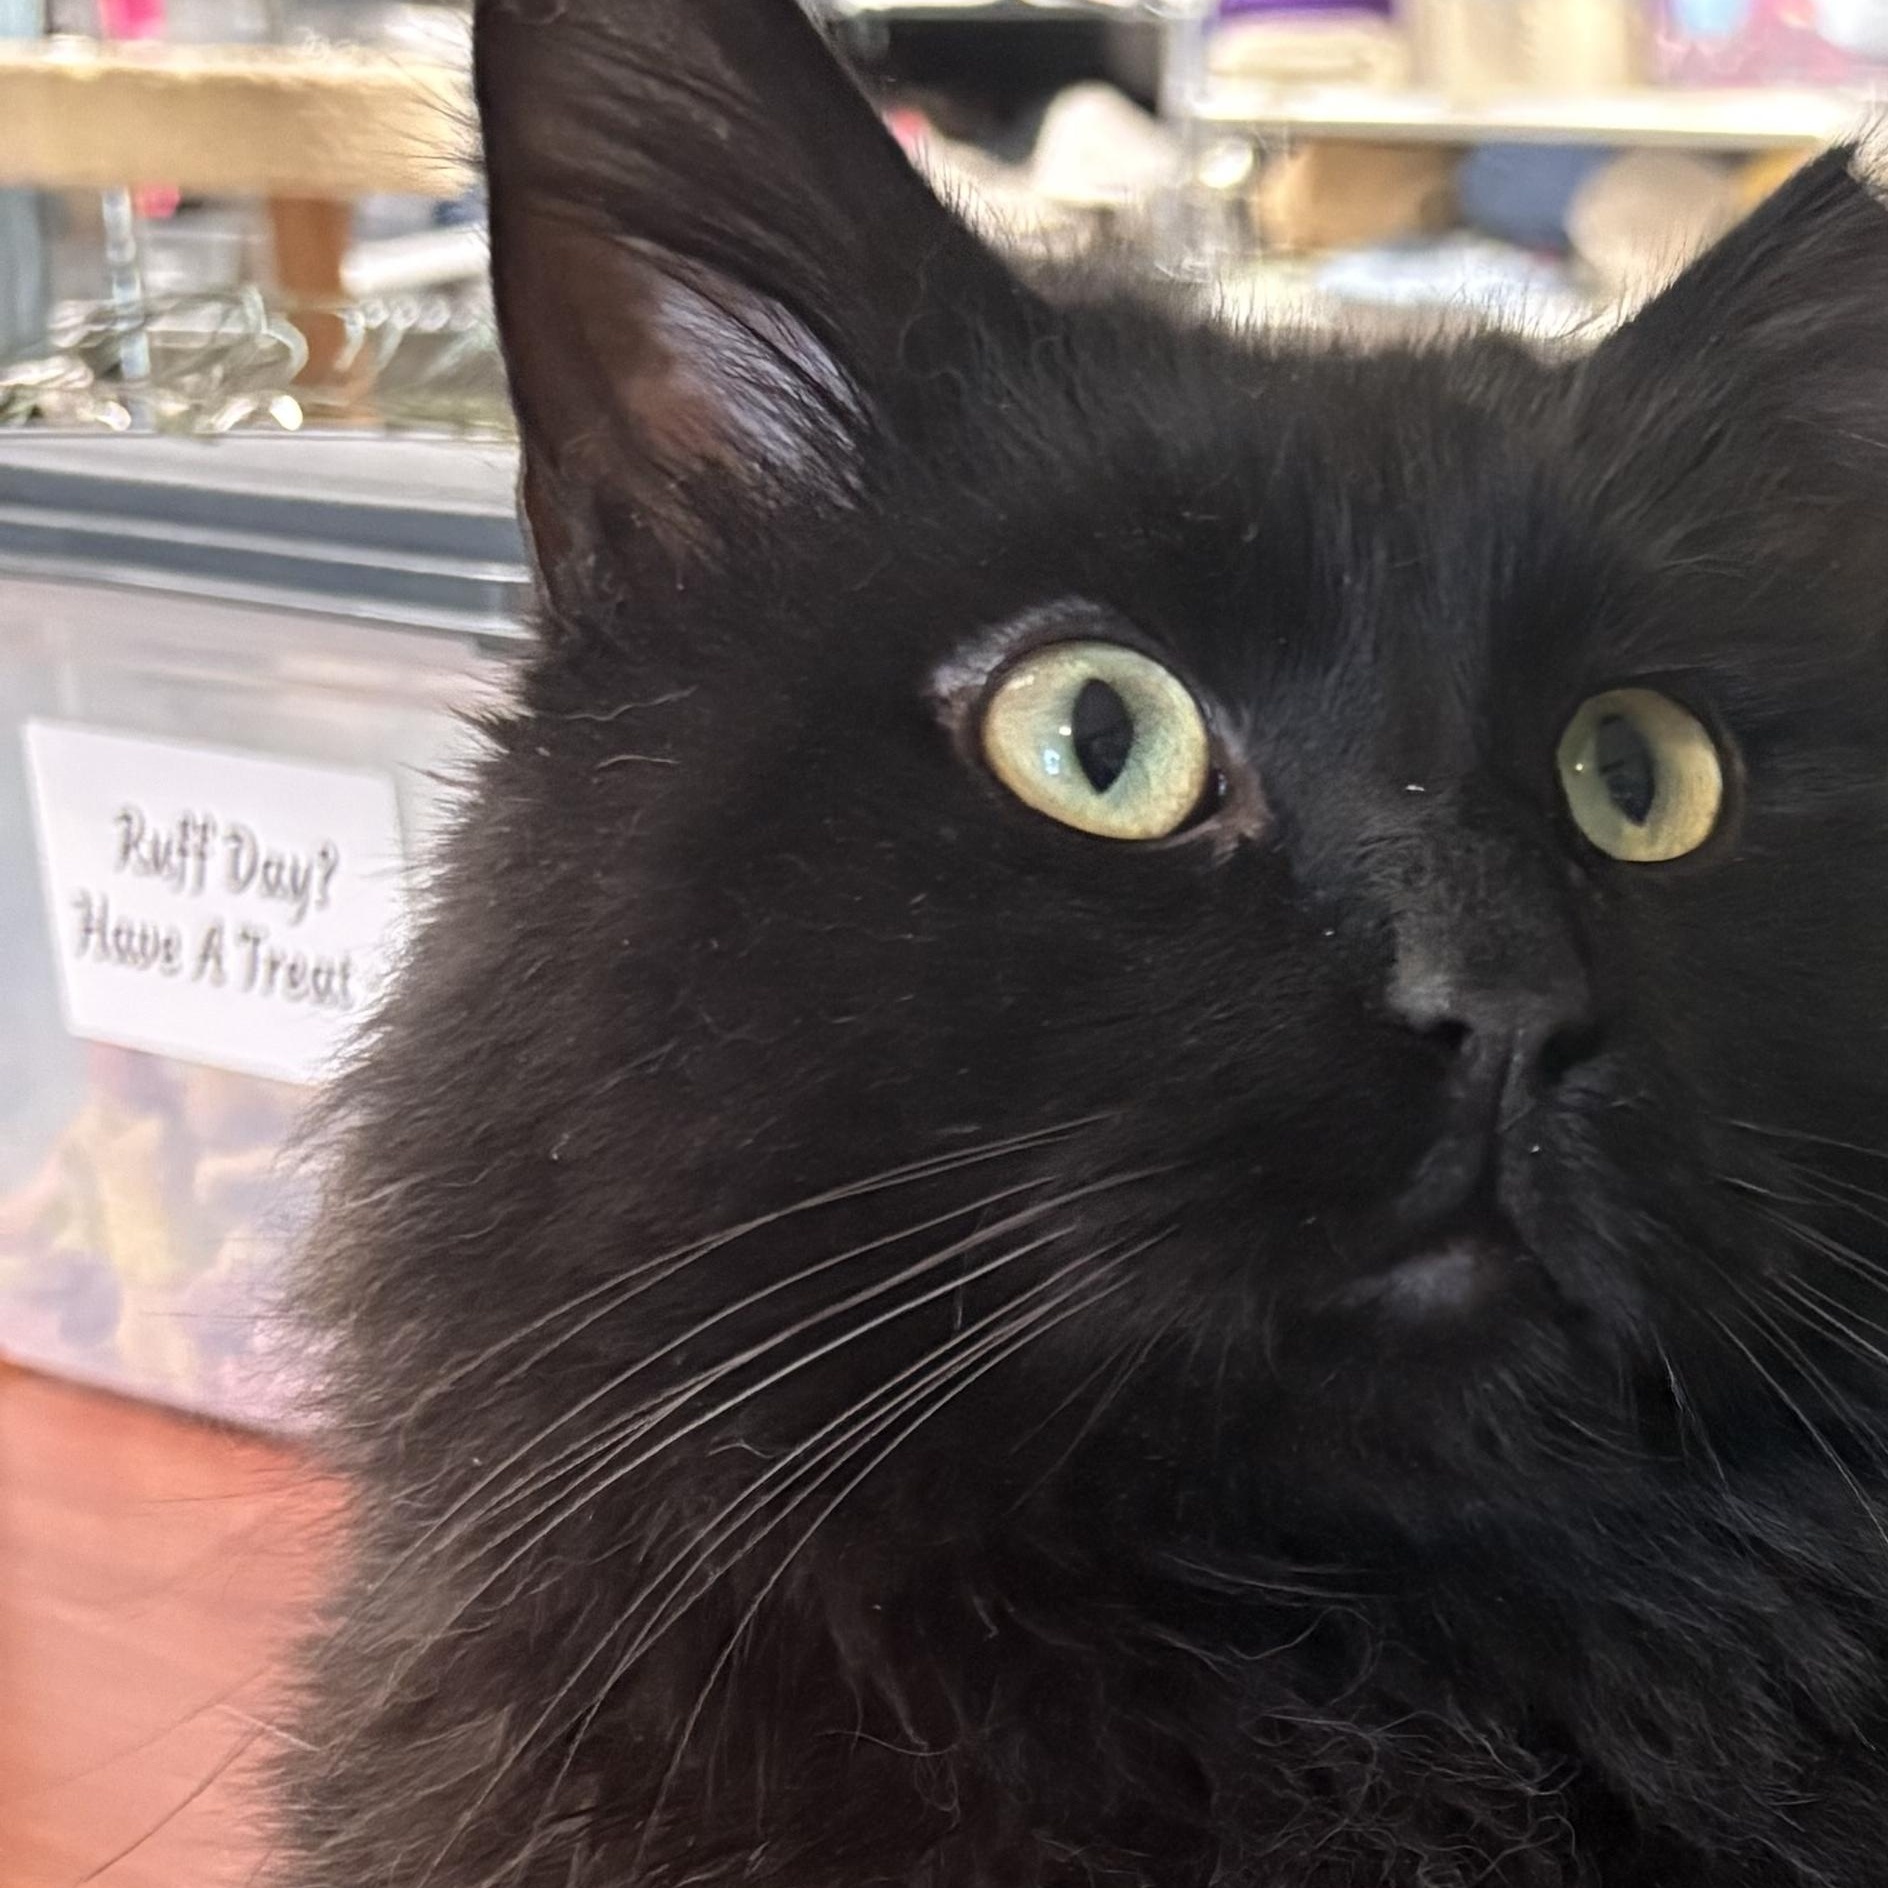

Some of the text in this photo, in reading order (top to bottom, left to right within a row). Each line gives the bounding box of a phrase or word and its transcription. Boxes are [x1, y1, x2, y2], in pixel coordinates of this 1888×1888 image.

[113, 804, 339, 924] Ruff Day?
[70, 890, 355, 1012] Have A Treat
